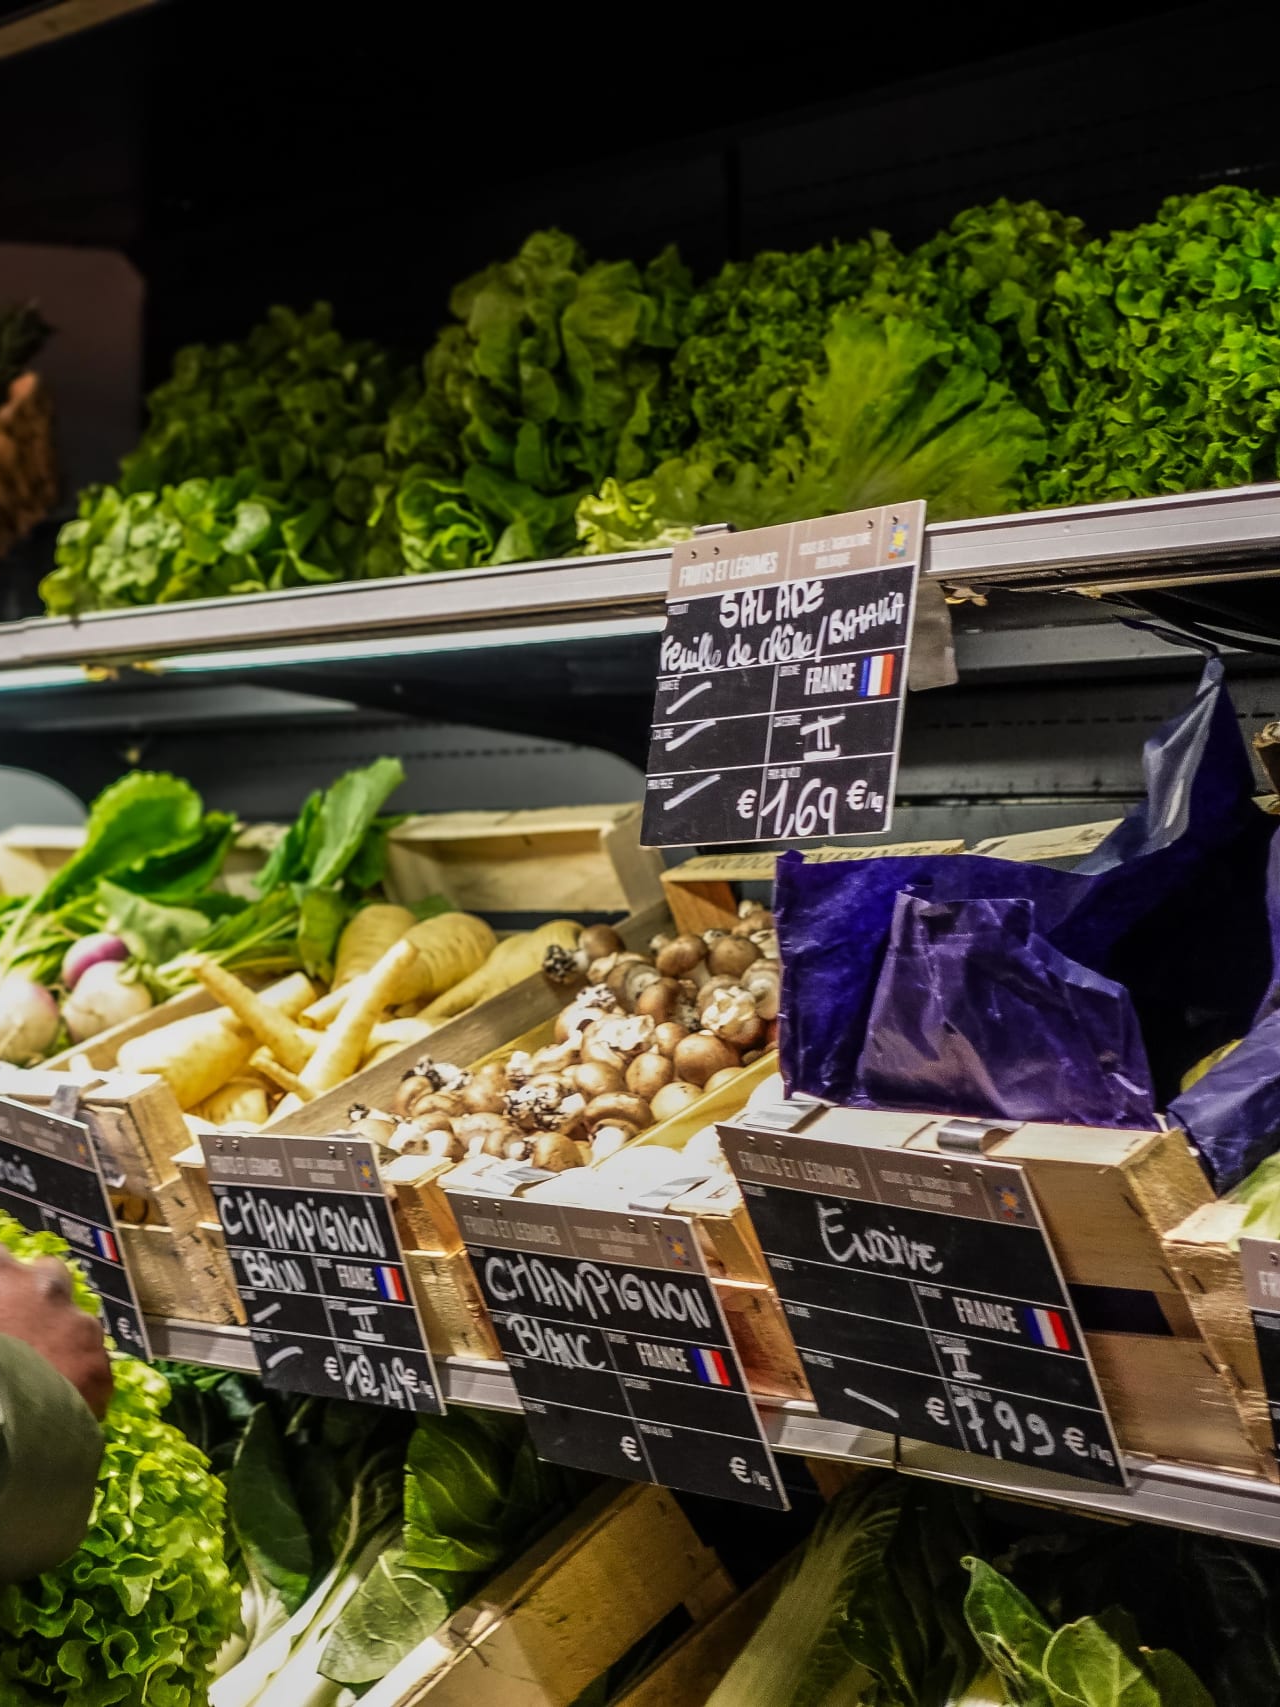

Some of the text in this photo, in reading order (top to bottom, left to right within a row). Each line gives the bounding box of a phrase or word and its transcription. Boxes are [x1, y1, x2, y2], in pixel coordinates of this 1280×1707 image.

[726, 633, 758, 668] de
[804, 662, 858, 696] FRANCE
[736, 788, 759, 819] €
[334, 1263, 378, 1292] FRANCE
[951, 1296, 1022, 1335] FRANCE
[634, 1340, 692, 1374] FRANCE
[924, 1396, 951, 1427] €
[619, 1435, 643, 1463] €
